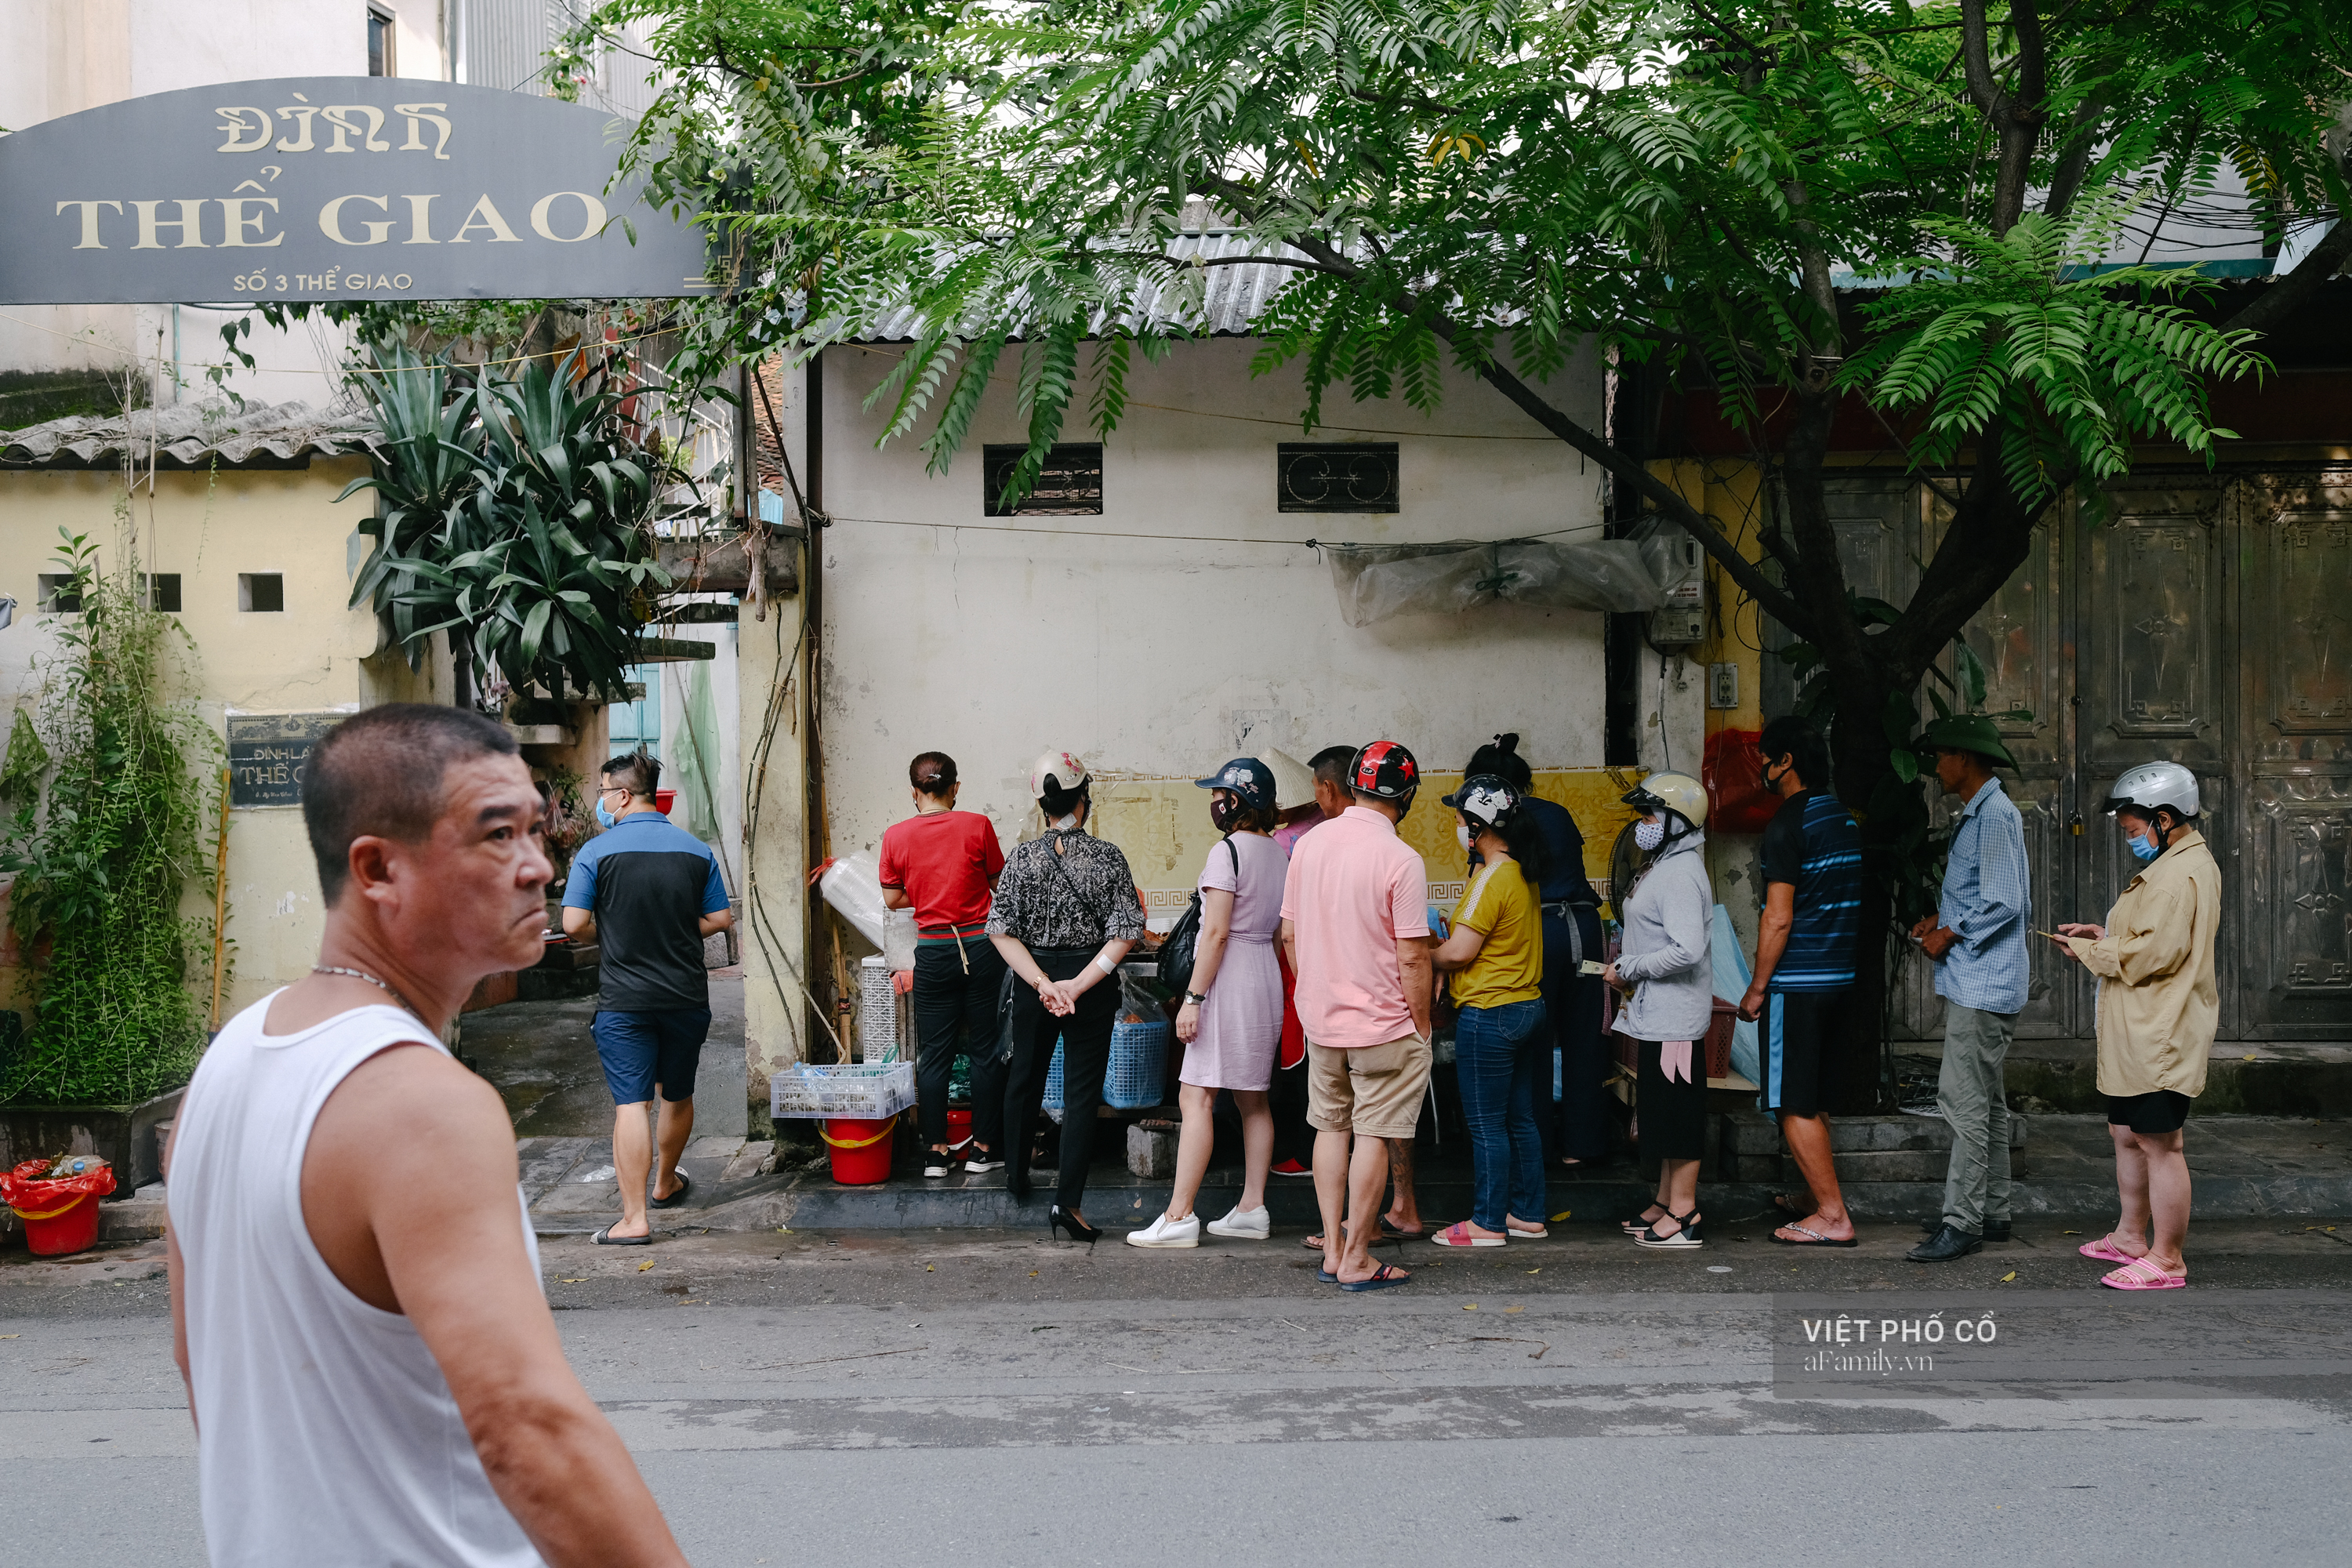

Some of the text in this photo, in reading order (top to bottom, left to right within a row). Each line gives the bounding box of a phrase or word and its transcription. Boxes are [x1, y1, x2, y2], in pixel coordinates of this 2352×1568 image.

[56, 165, 607, 250] THỂ GIAO
[234, 265, 413, 292] SỐ 3 THỂ GIAO
